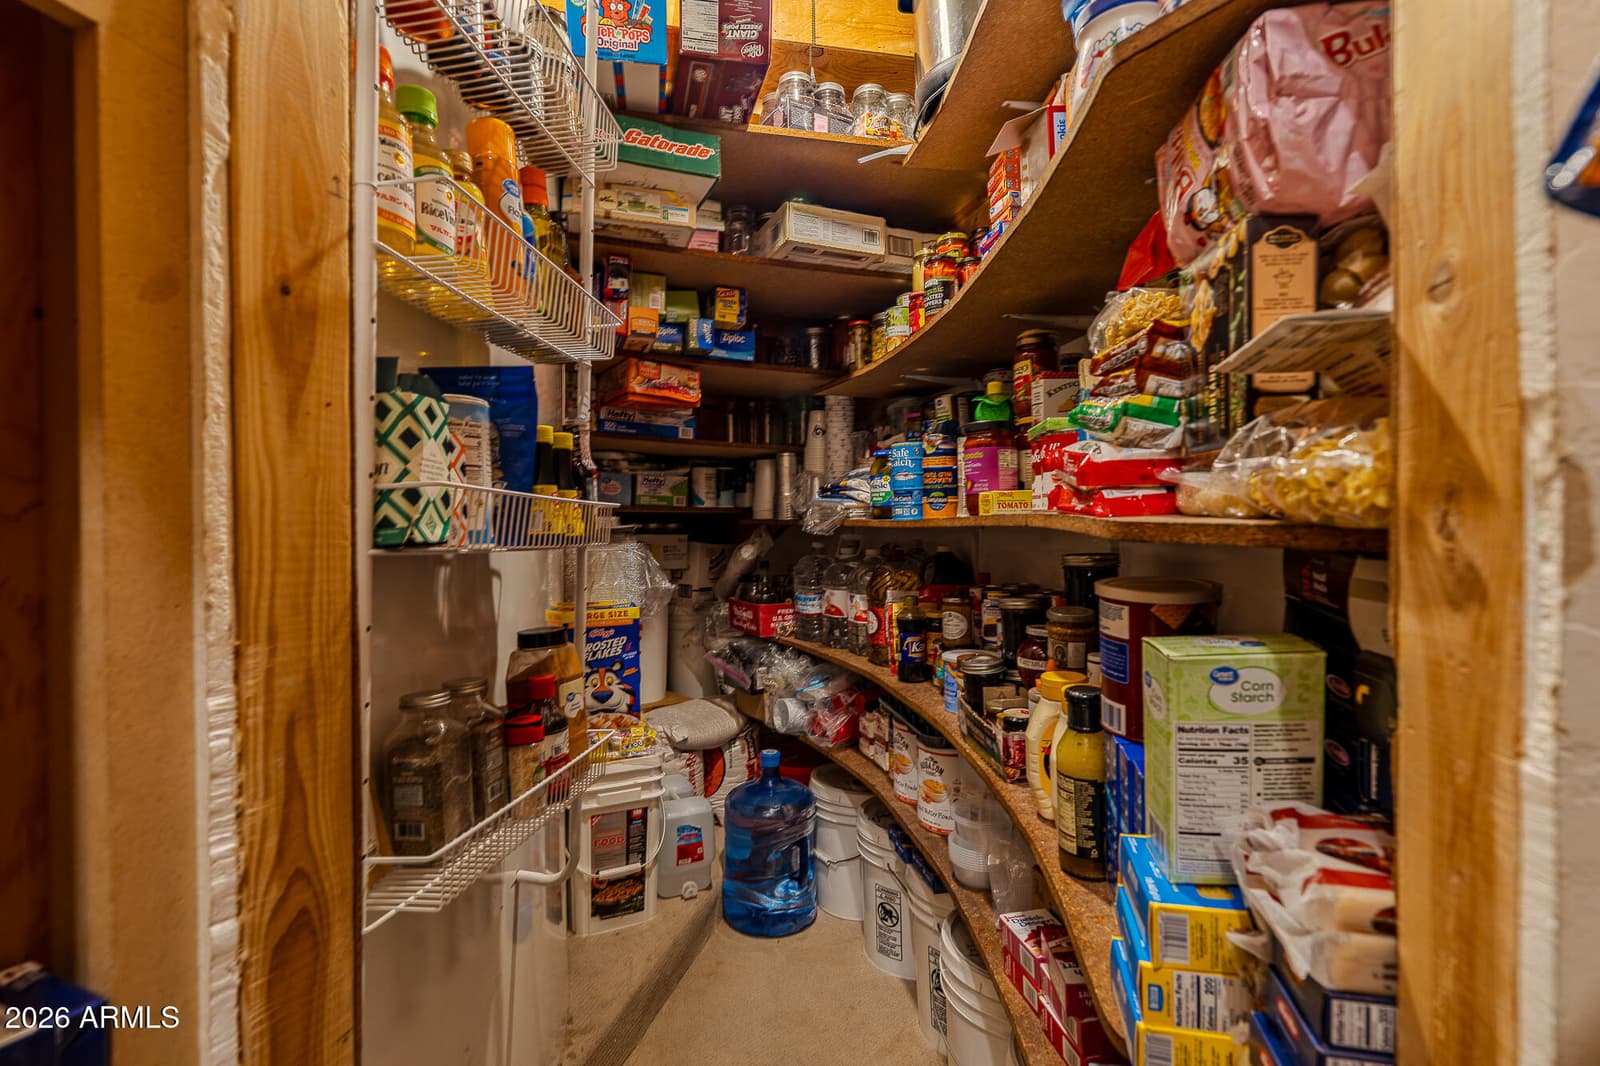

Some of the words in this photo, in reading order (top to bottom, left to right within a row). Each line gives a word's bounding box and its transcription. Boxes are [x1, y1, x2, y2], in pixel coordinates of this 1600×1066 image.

[726, 30, 759, 39] GIANT
[597, 38, 638, 51] Original
[624, 129, 714, 160] Gatorade
[421, 202, 446, 219] Rice
[892, 447, 910, 459] Safe
[996, 502, 1029, 510] TOMATO
[586, 611, 605, 620] RGE
[608, 610, 629, 619] SIZE
[585, 635, 628, 653] ROSTED
[1240, 680, 1274, 692] Corn
[1231, 692, 1275, 704] Starch
[1177, 726, 1221, 735] Nutrition
[1222, 726, 1249, 735] Facts
[1177, 757, 1218, 765] Calories
[1232, 756, 1249, 766] 35
[593, 835, 625, 849] FOOD
